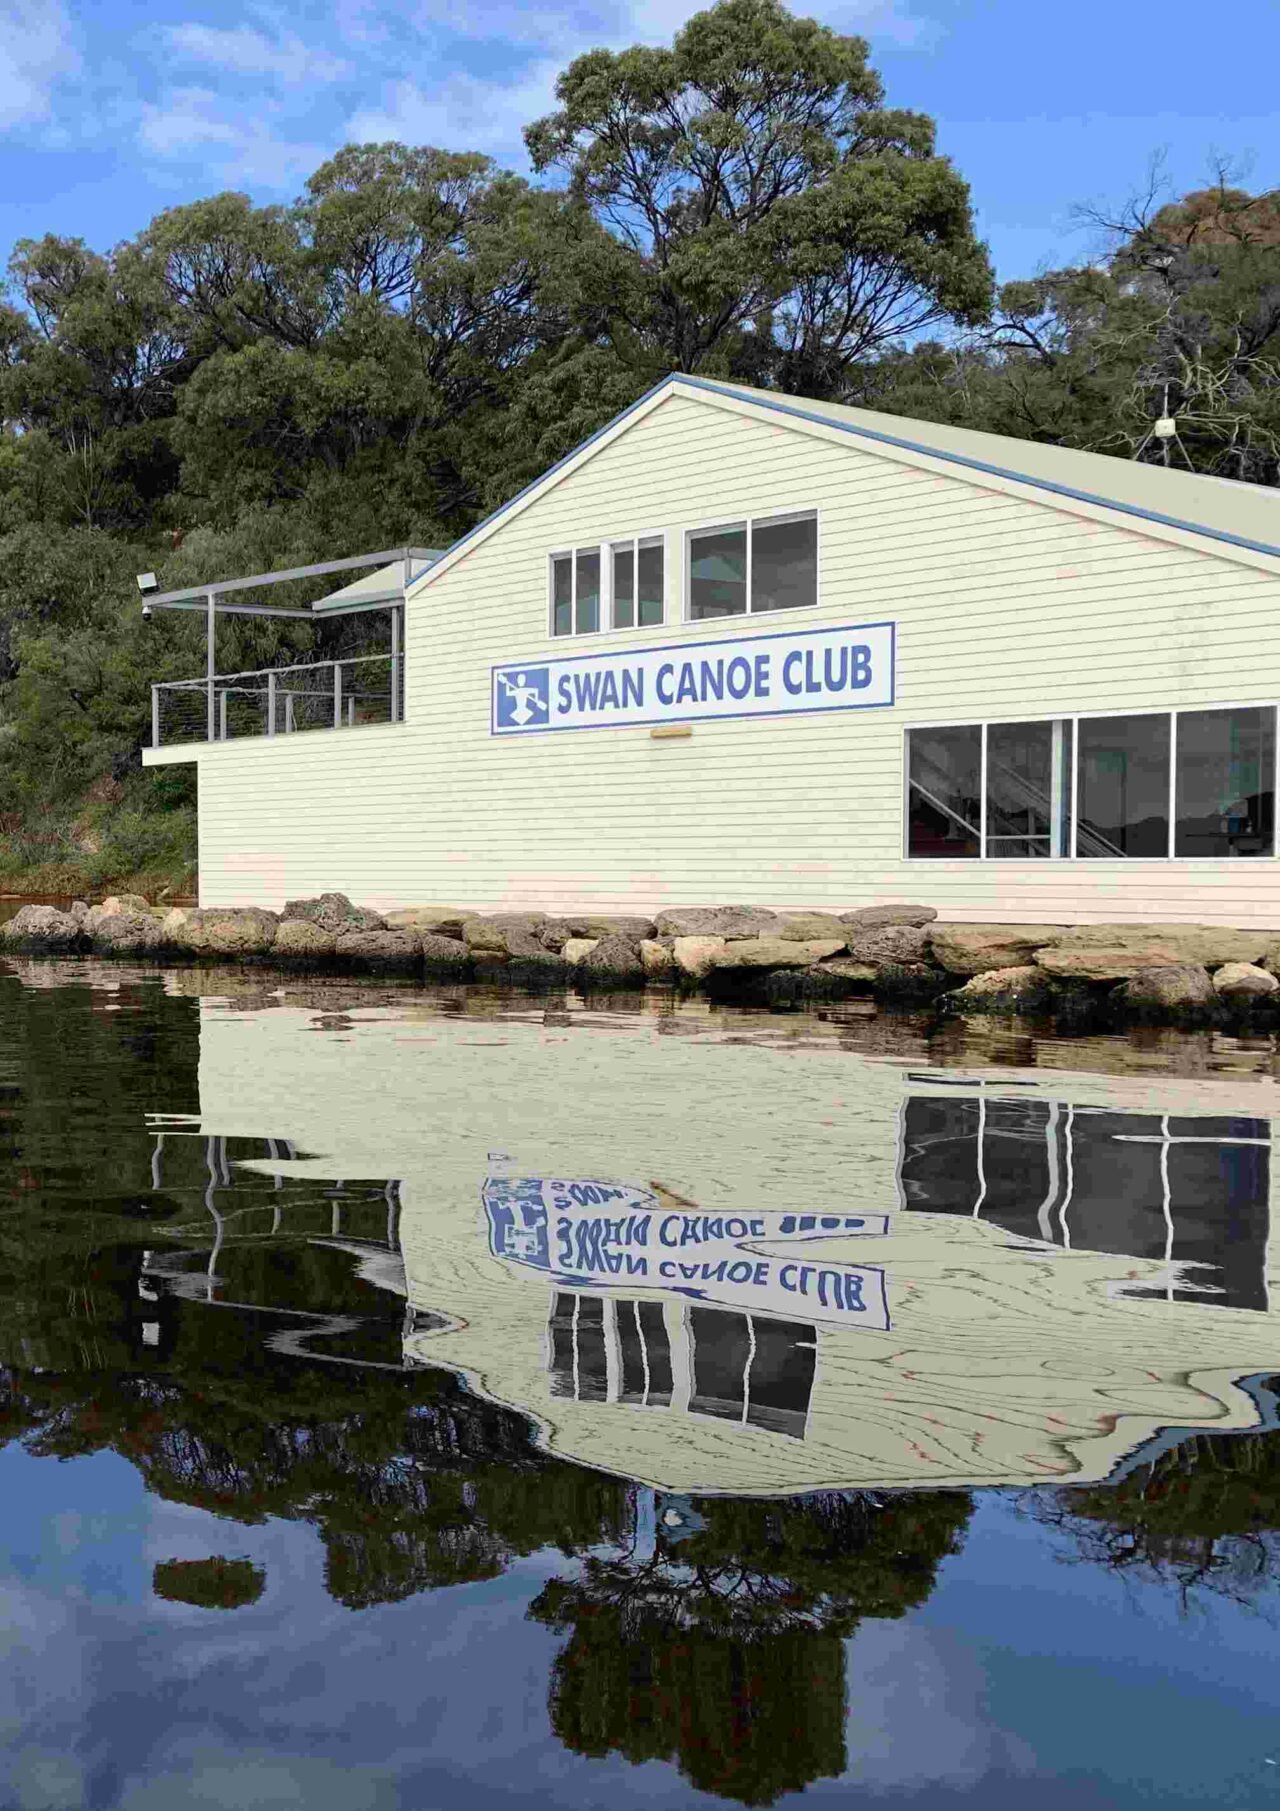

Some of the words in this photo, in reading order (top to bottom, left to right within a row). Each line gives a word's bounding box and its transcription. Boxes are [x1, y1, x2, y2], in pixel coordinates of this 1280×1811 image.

[556, 667, 644, 714] SWAN
[655, 654, 771, 706] CANOE
[782, 644, 873, 696] CLUB
